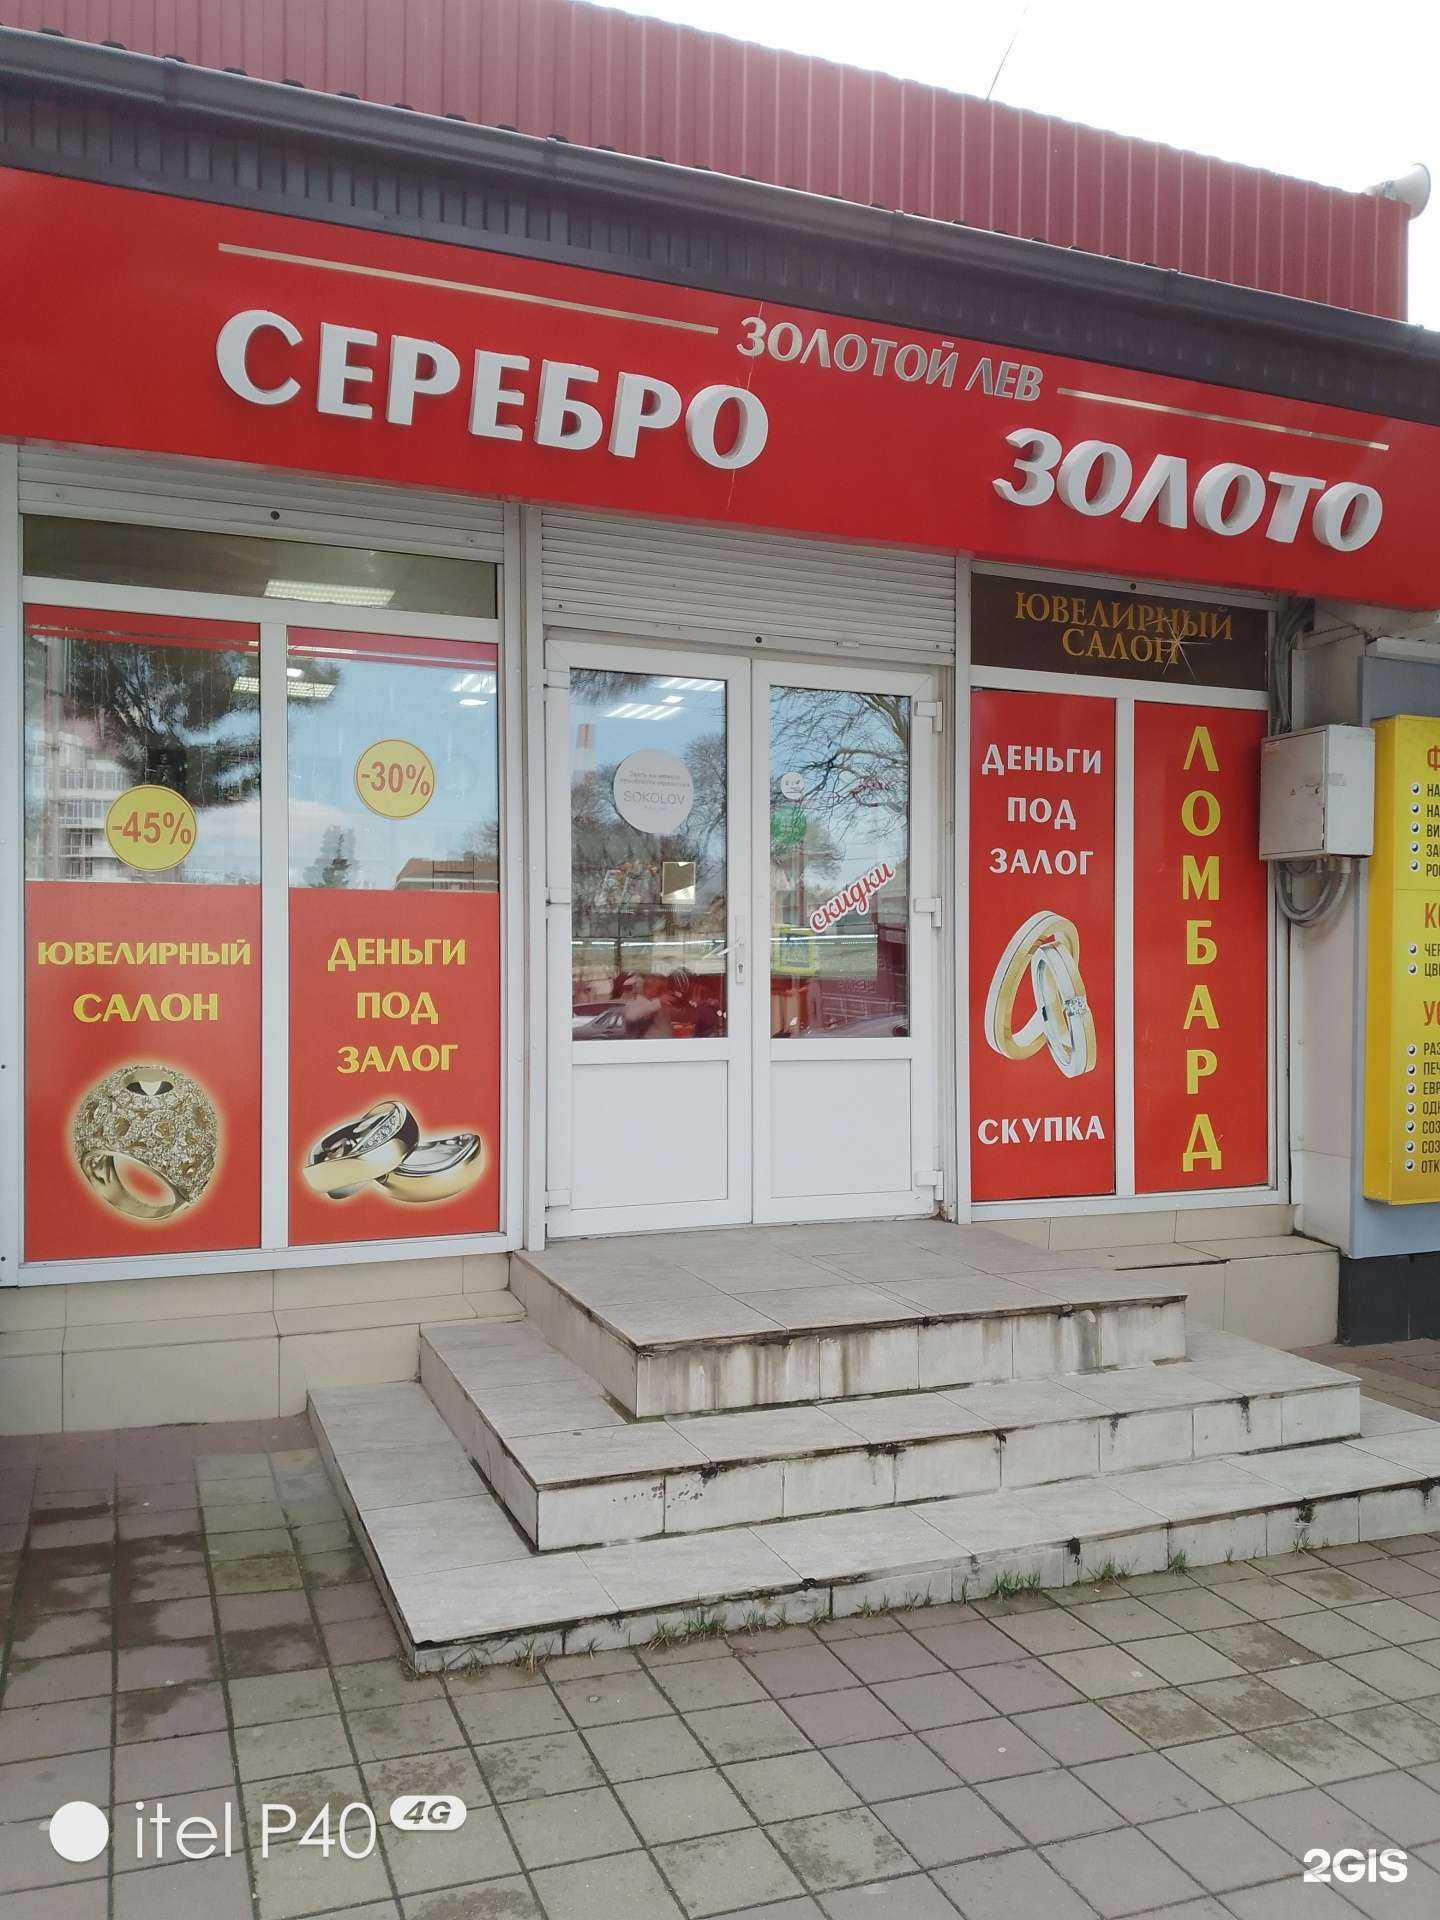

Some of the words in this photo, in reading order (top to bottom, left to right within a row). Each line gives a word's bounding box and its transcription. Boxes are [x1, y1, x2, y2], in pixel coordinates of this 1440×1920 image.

[736, 316, 959, 388] ЗОЛОТОЙ
[965, 357, 1044, 402] ЛЕВ
[216, 310, 768, 470] СЕРЕБРО
[992, 428, 1383, 552] ЗОЛОТО
[1015, 591, 1233, 641] ЮВЕЛИРНЫЙ
[1062, 628, 1178, 664] САЛОН
[982, 744, 1101, 775] ДЕНЬГИ
[361, 761, 430, 797] -30%
[623, 790, 686, 805] SOKOLOV
[1007, 797, 1076, 830] ПОД
[111, 811, 192, 845] -45%
[989, 848, 1093, 875] ЗАЛОГ
[809, 861, 896, 933] скидки
[38, 938, 252, 966] ЮВЕЛИРНЫЙ
[327, 938, 466, 971] ДЕНЬГИ
[1181, 726, 1222, 1172] ЛОМБАРД
[73, 993, 219, 1023] САЛОН
[356, 991, 439, 1025] ПОД
[336, 1044, 458, 1074] ЗАЛОГ
[978, 1115, 1104, 1145] СКУПКА
